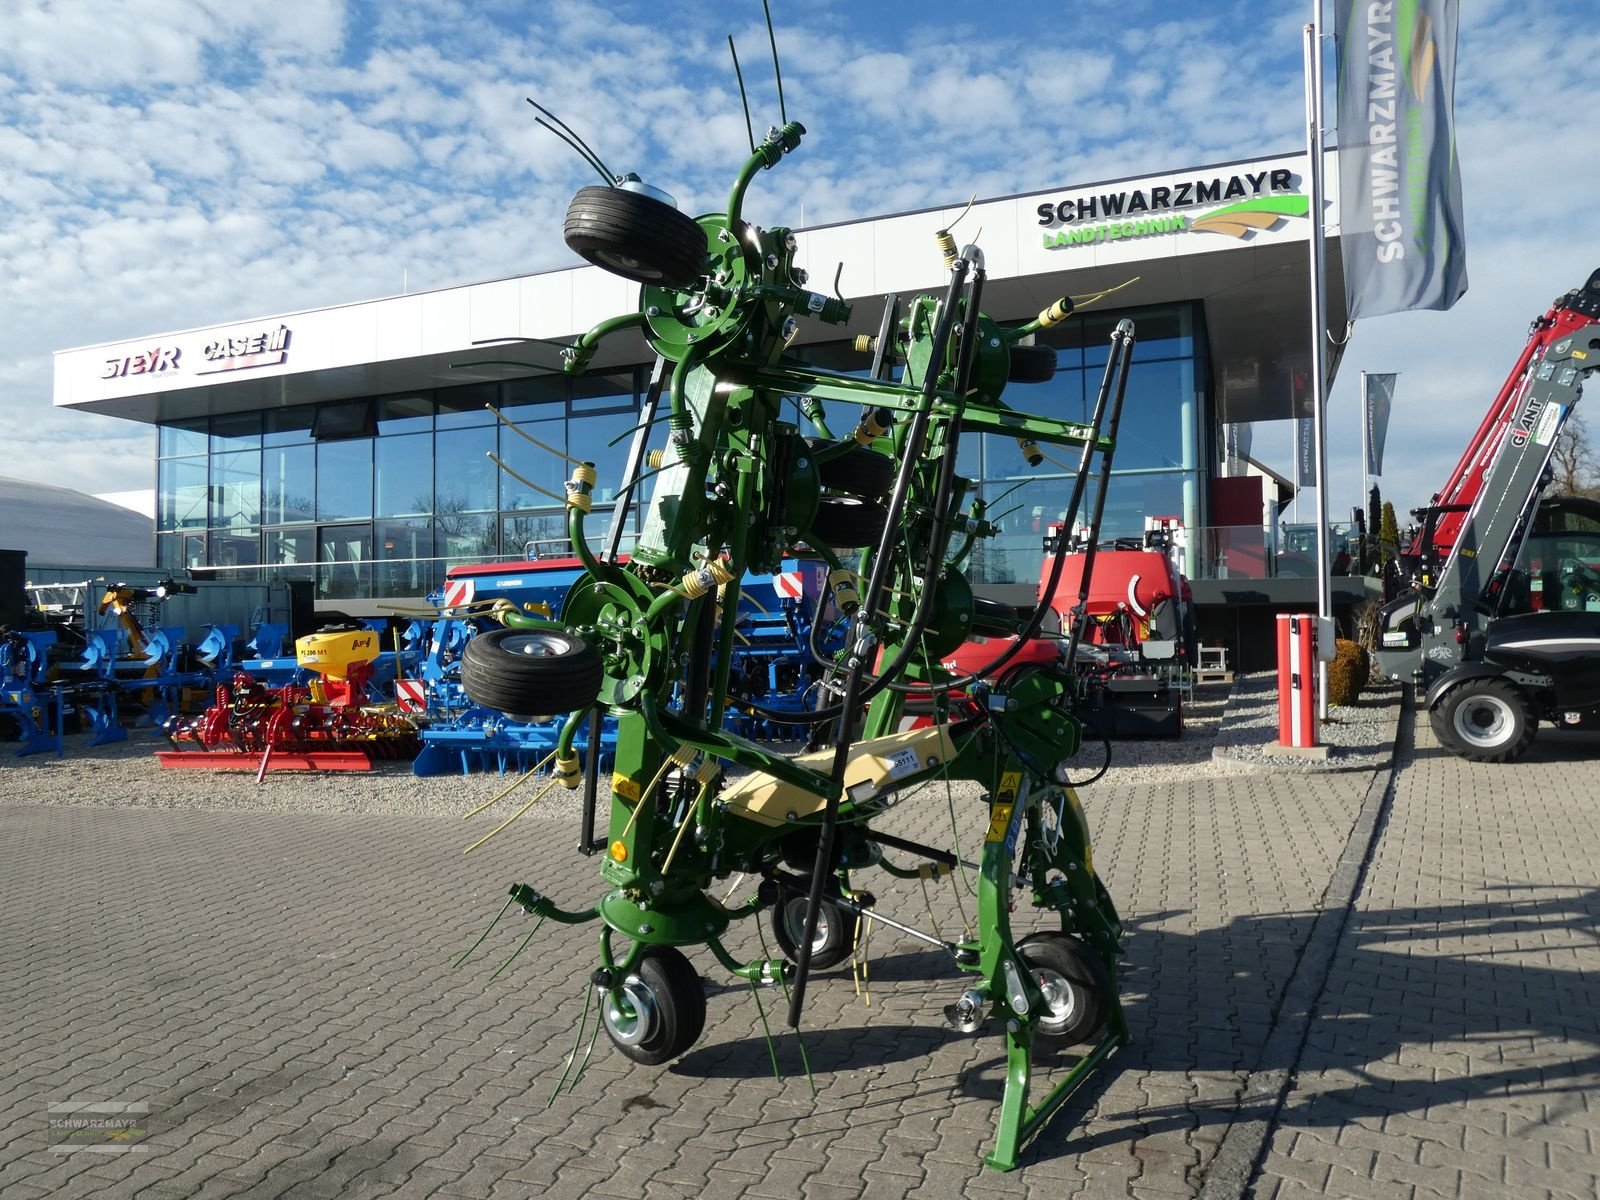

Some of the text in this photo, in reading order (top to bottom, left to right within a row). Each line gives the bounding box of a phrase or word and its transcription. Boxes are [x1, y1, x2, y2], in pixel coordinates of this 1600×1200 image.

[1367, 0, 1404, 263] SCHWARZMAYR
[1037, 168, 1292, 227] SCHWARZMAYR
[1042, 215, 1187, 249] LANDTECHNIK
[100, 347, 182, 380] STEYR
[204, 333, 267, 361] CASE
